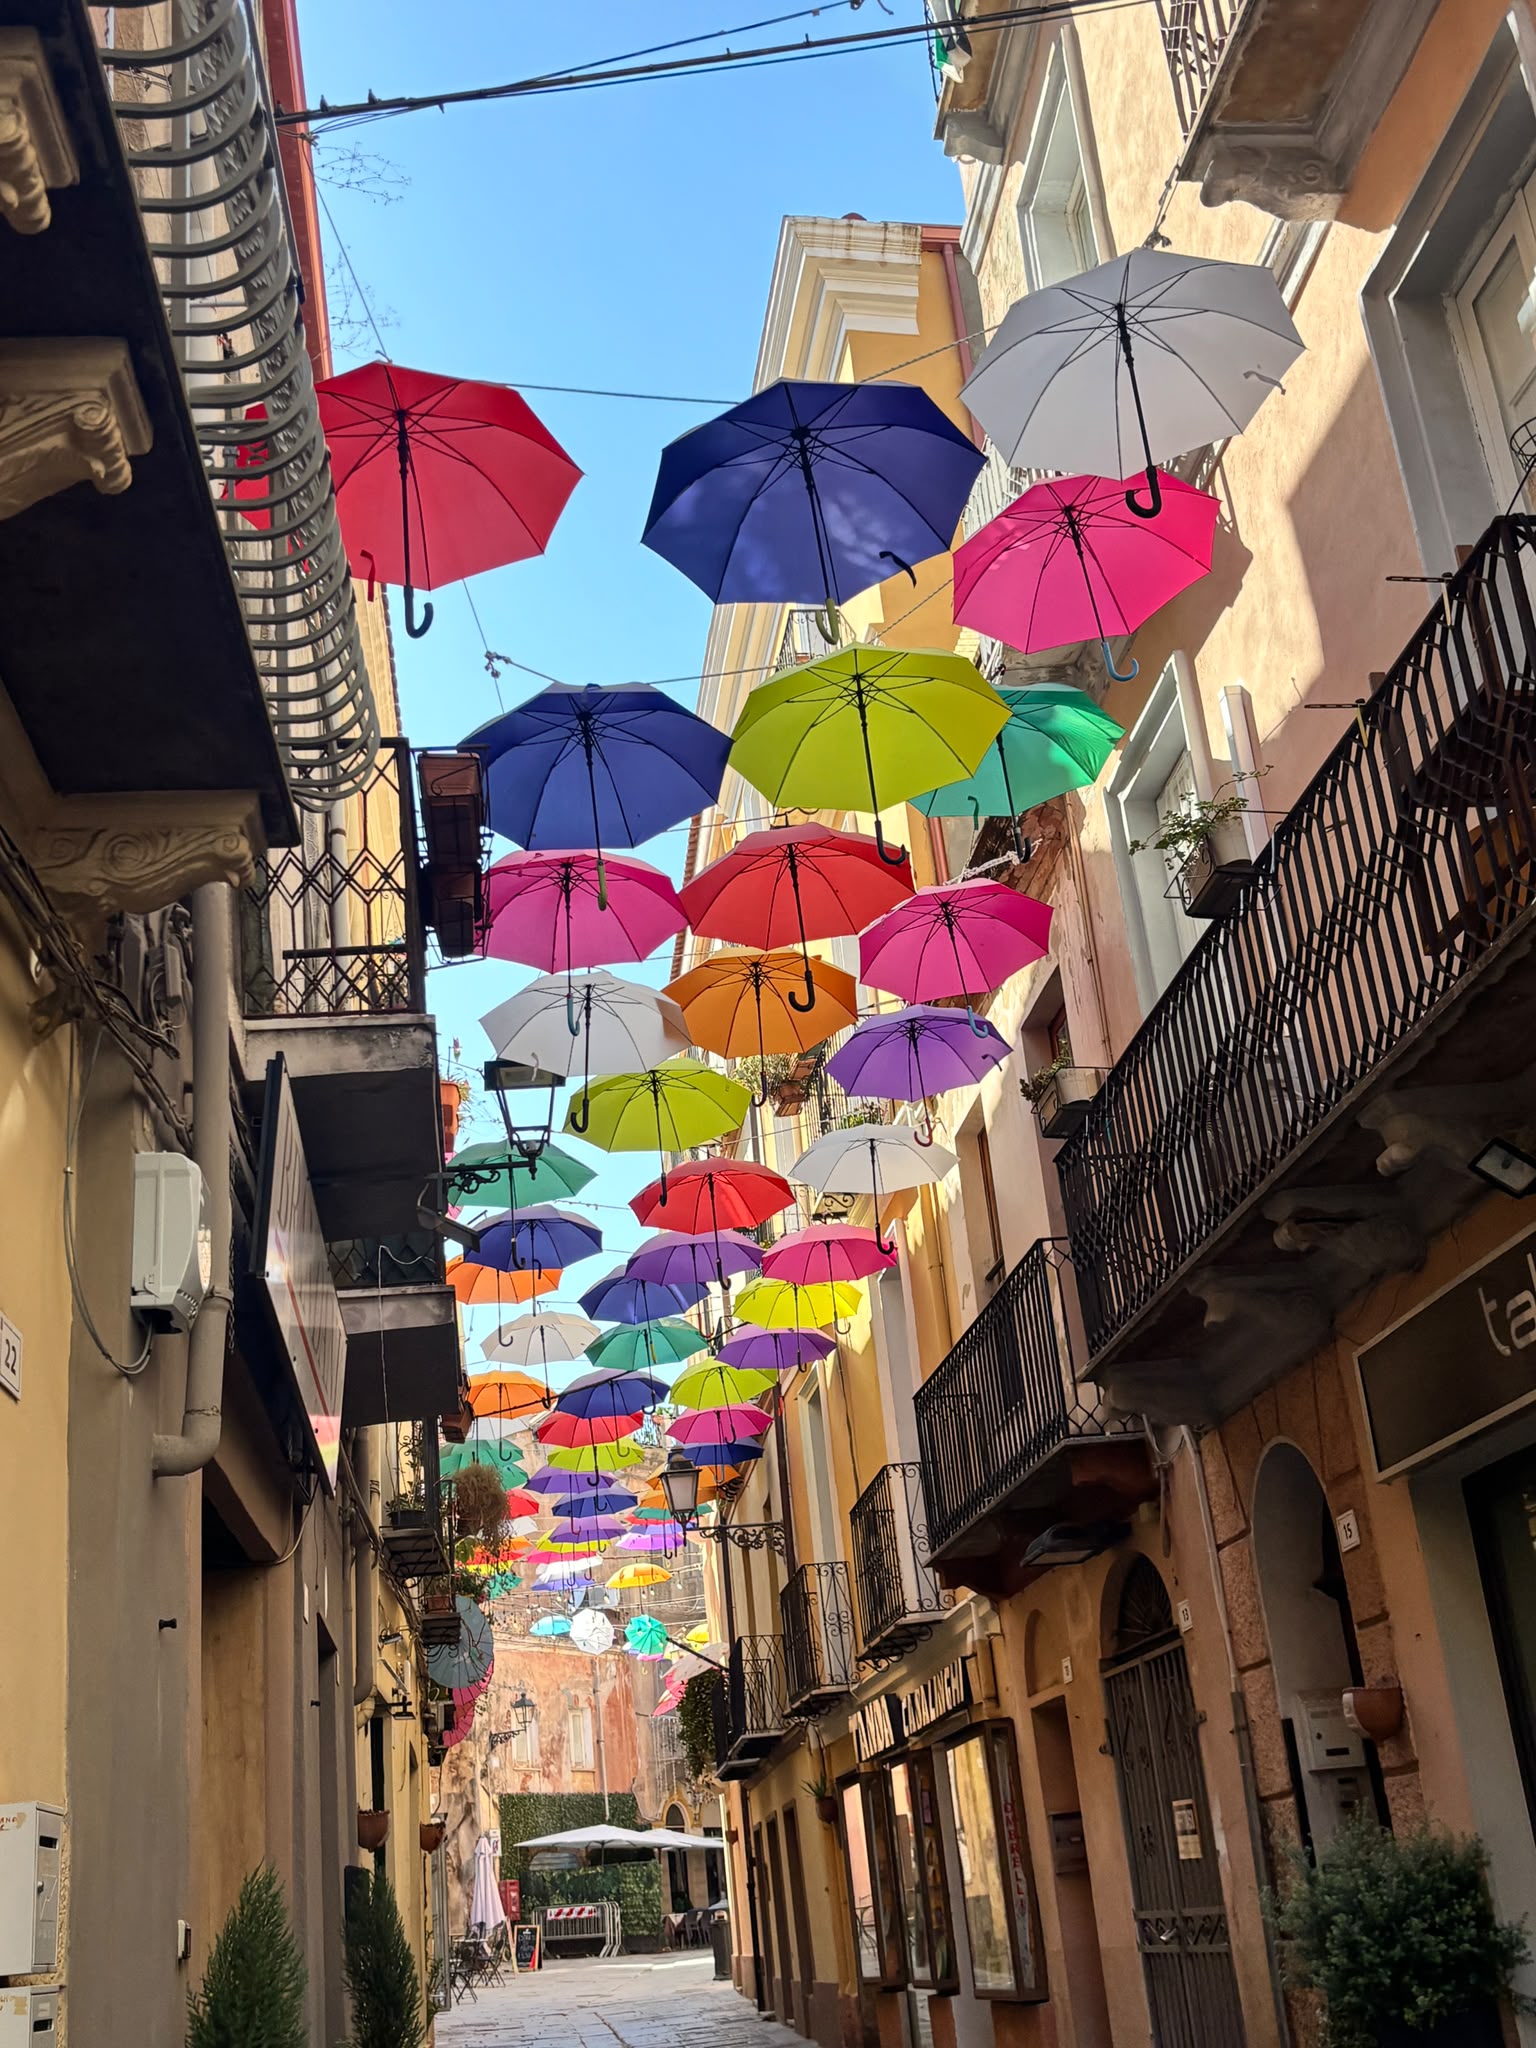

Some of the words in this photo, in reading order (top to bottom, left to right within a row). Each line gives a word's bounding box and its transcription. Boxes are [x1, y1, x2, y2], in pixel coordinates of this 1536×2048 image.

[5, 1338, 17, 1376] 22
[1343, 1522, 1353, 1540] 15
[1182, 1607, 1189, 1622] 13
[848, 1694, 895, 1764] TANDA
[901, 1657, 965, 1738] CASALINGHI
